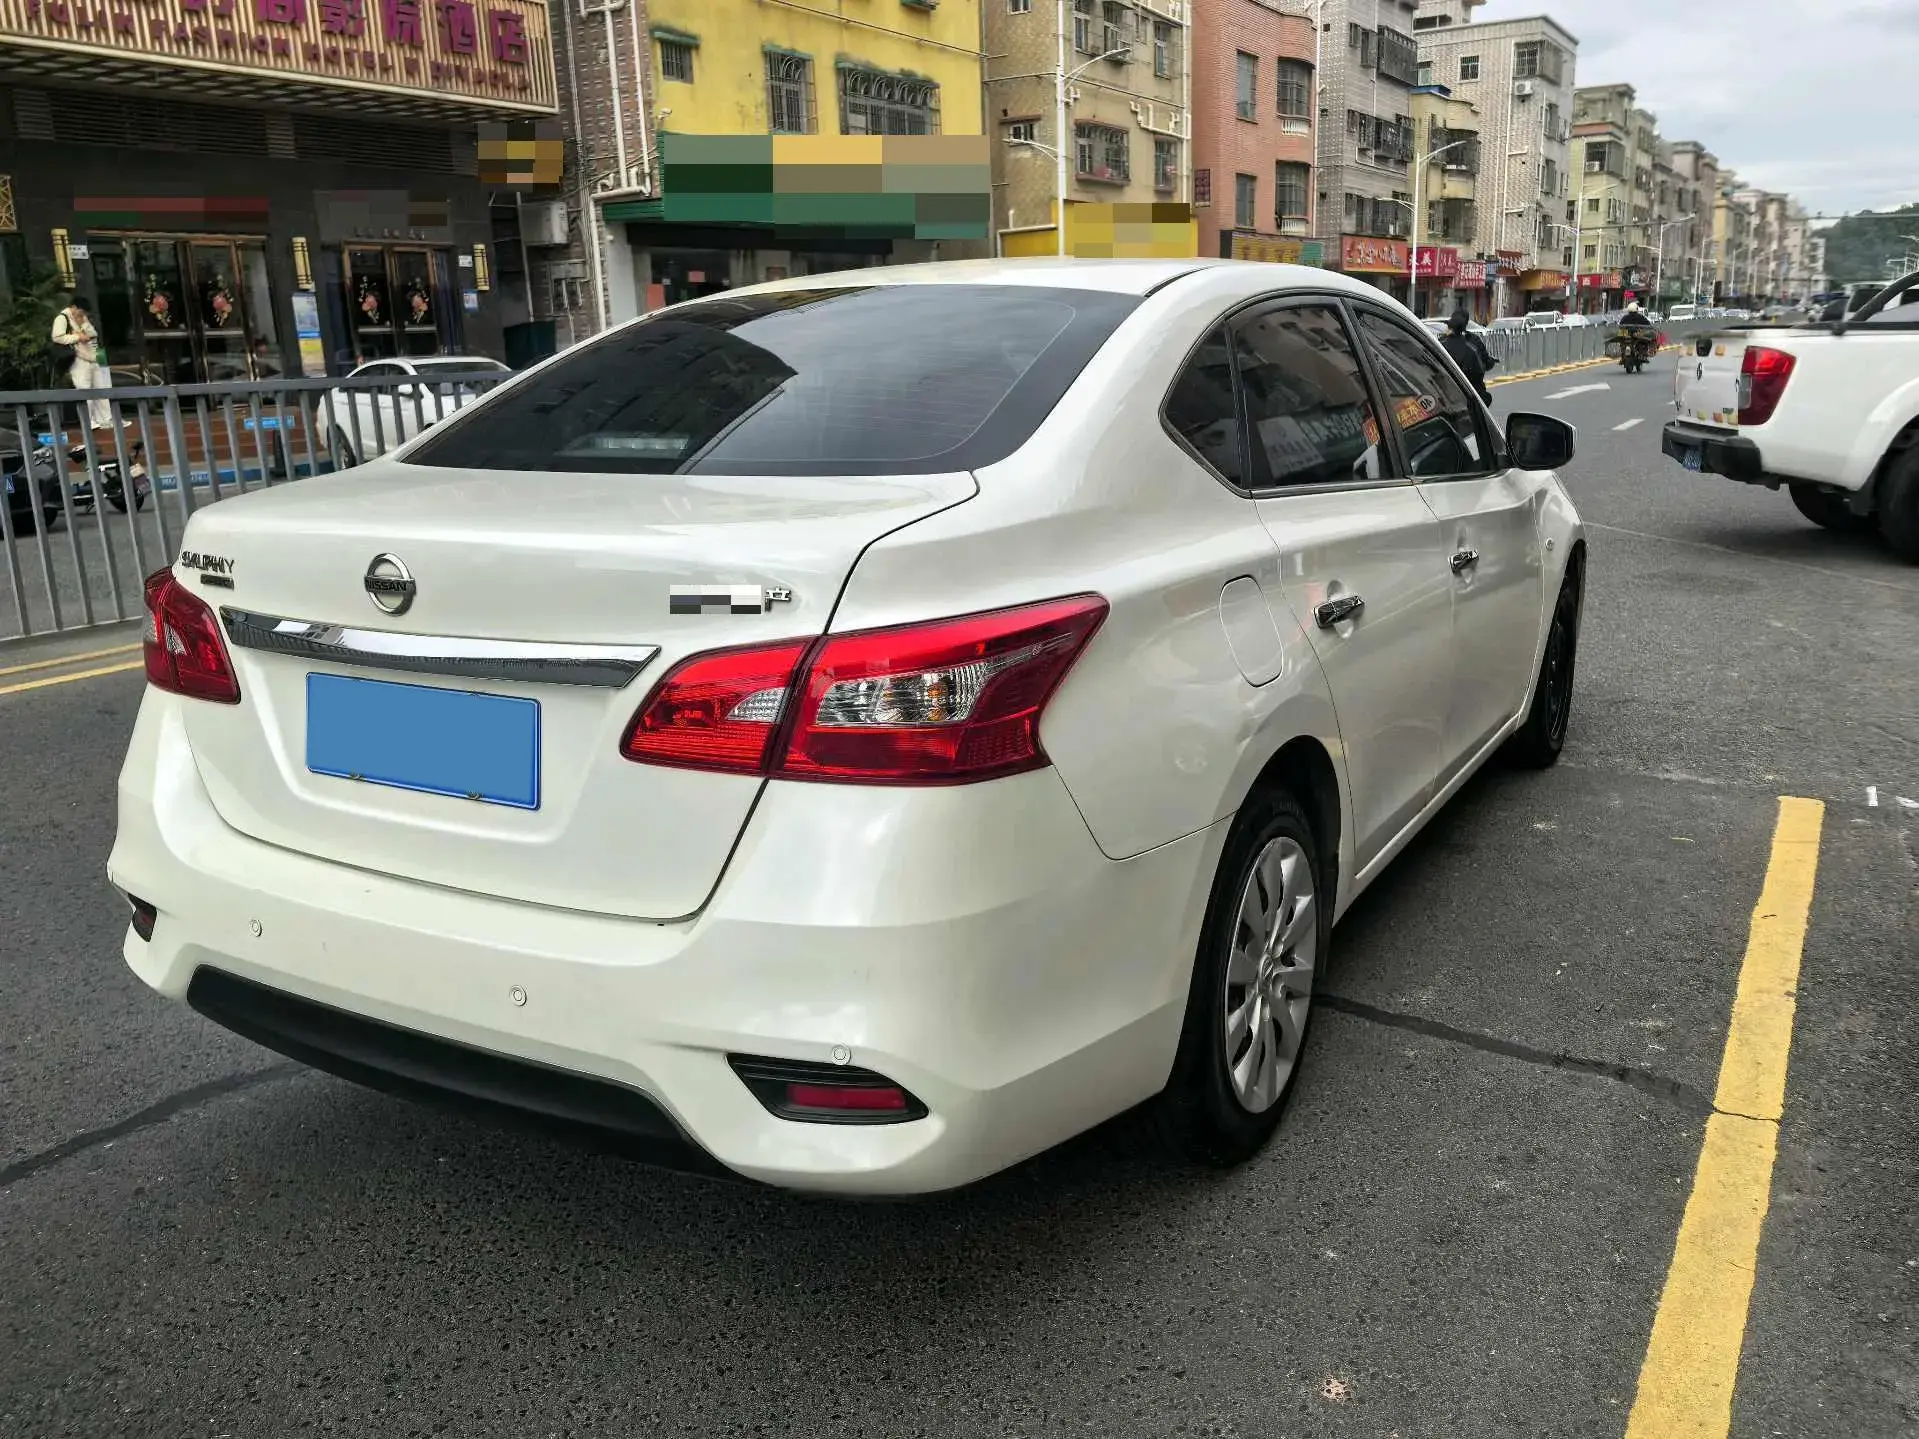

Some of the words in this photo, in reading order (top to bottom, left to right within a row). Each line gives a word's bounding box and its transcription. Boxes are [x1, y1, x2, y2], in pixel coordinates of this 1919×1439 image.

[150, 17, 291, 57] FASHION
[304, 41, 393, 72] HOTEL
[365, 578, 408, 592] NISSAN
